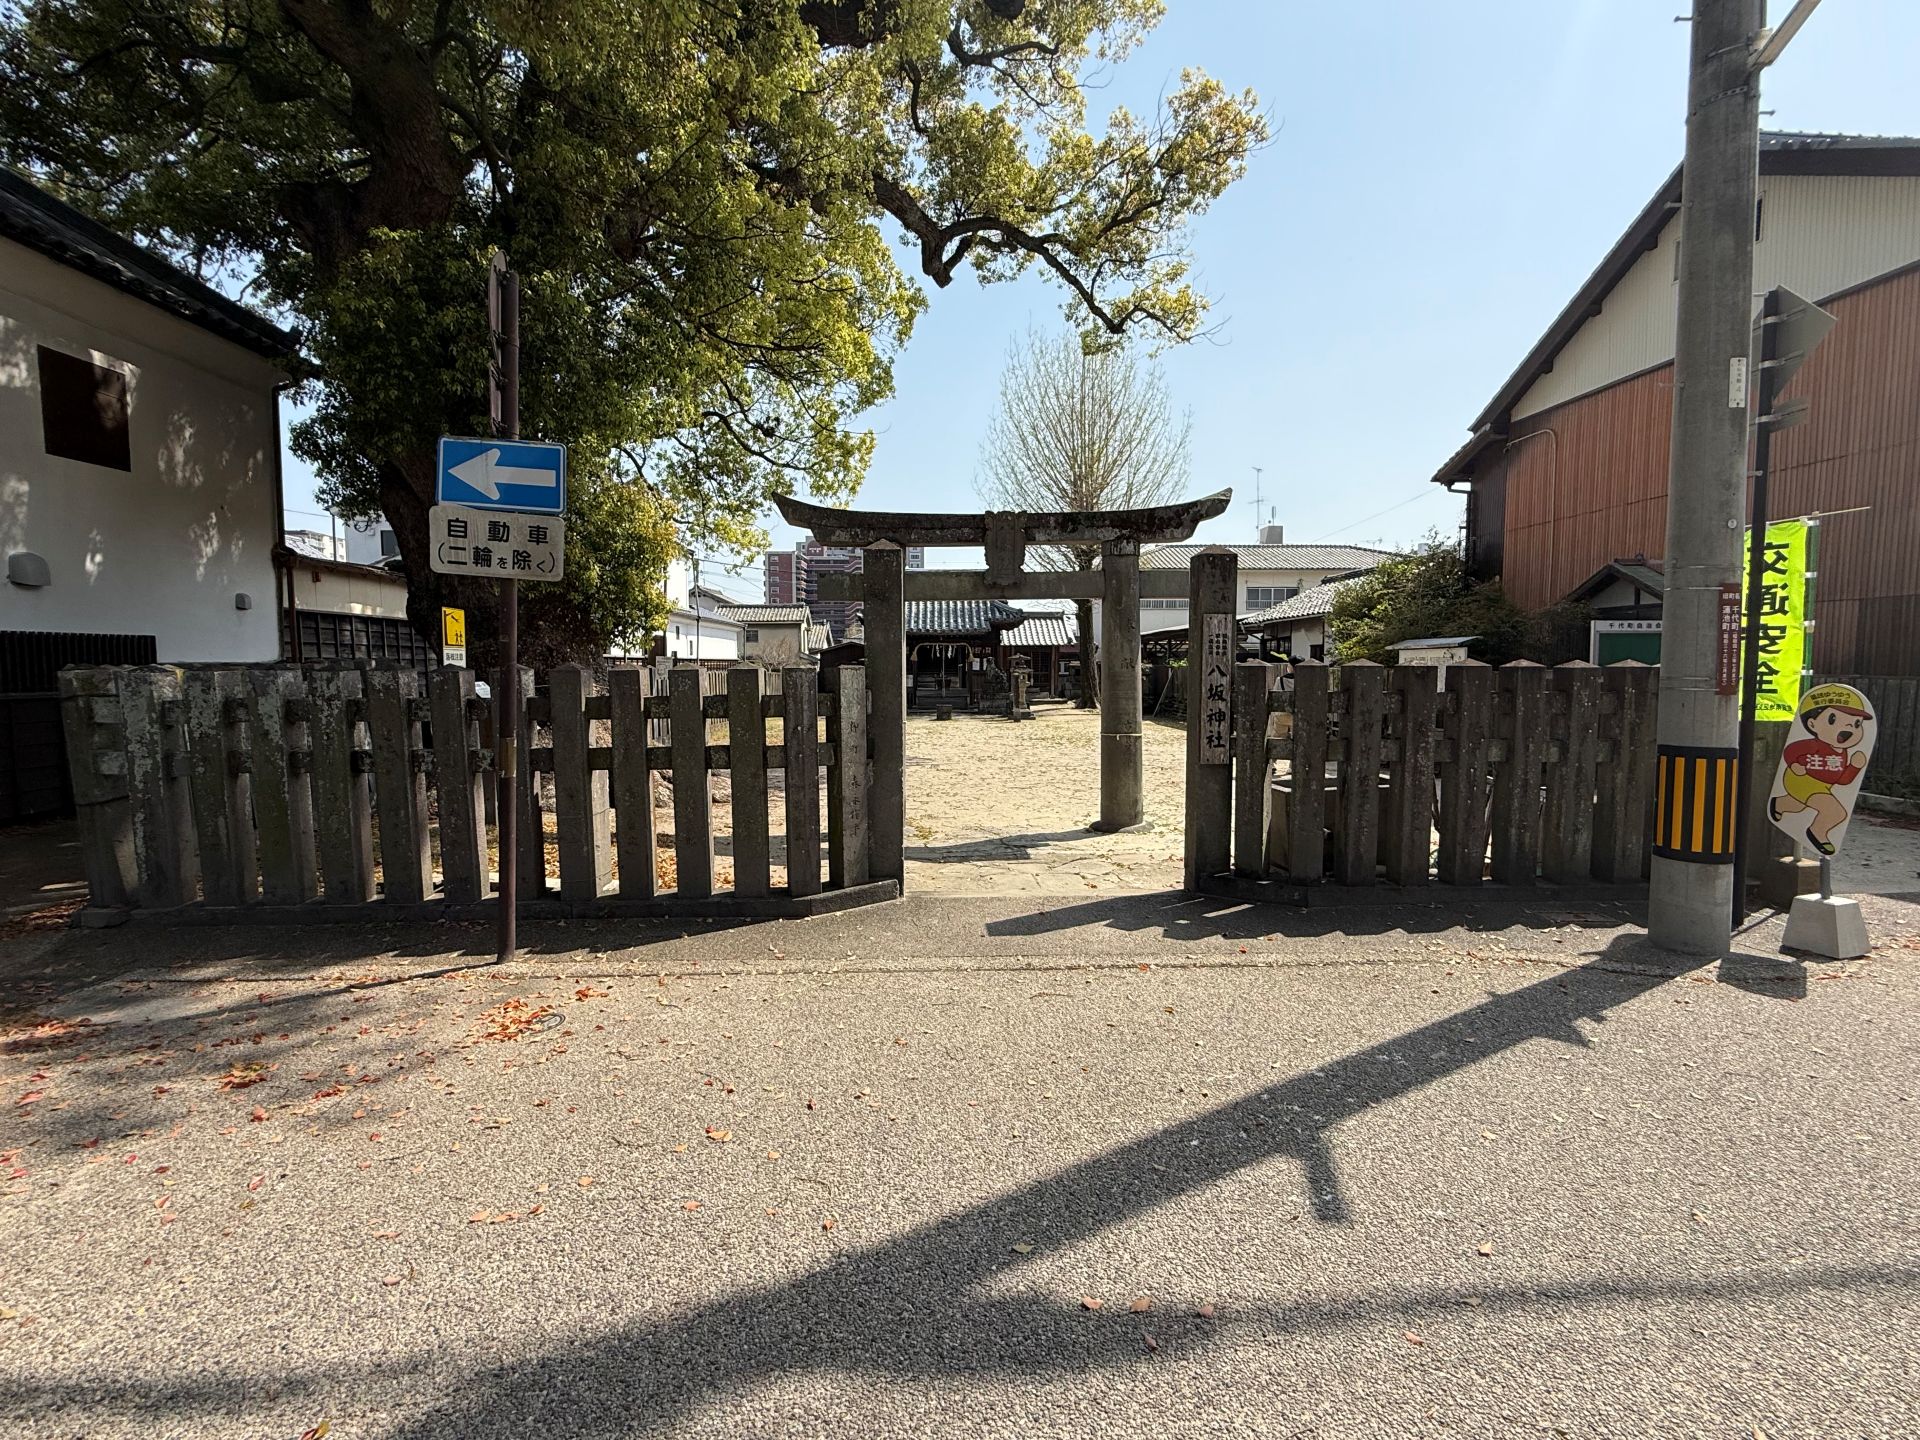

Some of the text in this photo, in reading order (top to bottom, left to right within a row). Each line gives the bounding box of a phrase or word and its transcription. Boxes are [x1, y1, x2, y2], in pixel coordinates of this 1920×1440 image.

[447, 518, 549, 546] 自動車
[438, 542, 555, 574] （二輪を除く）
[1731, 605, 1740, 631] 千代町
[1206, 665, 1228, 749] 八坂神社
[1806, 755, 1844, 771] 注意
